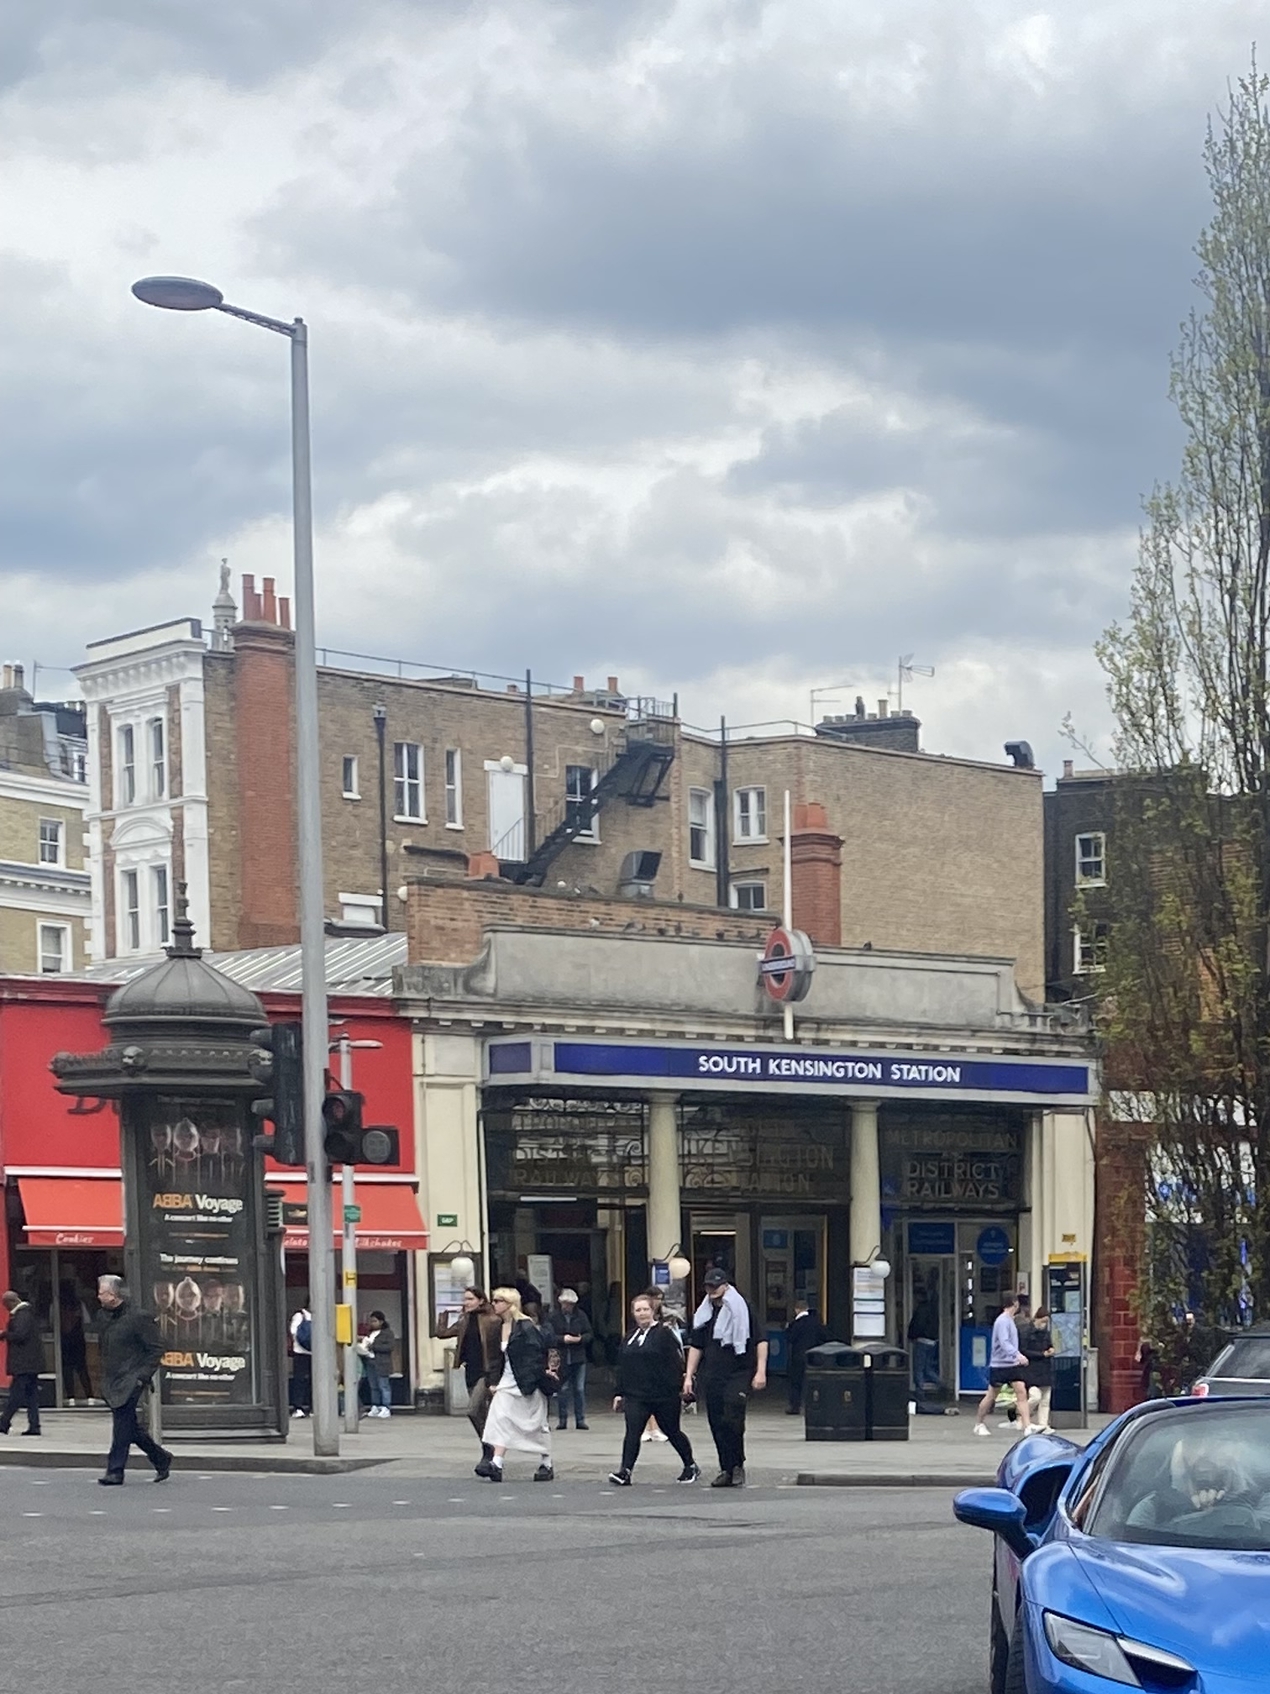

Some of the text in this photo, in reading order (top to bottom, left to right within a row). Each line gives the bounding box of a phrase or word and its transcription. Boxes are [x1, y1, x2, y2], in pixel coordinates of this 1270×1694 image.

[699, 1056, 961, 1082] SOUTH KENSINGTON STATION
[907, 1160, 1000, 1179] DISTRICT
[906, 1180, 1000, 1199] RAILWAYS
[153, 1193, 243, 1213] ABBA Voyage
[284, 1237, 402, 1248] elato ilkshakes
[196, 1353, 246, 1372] Voyage
